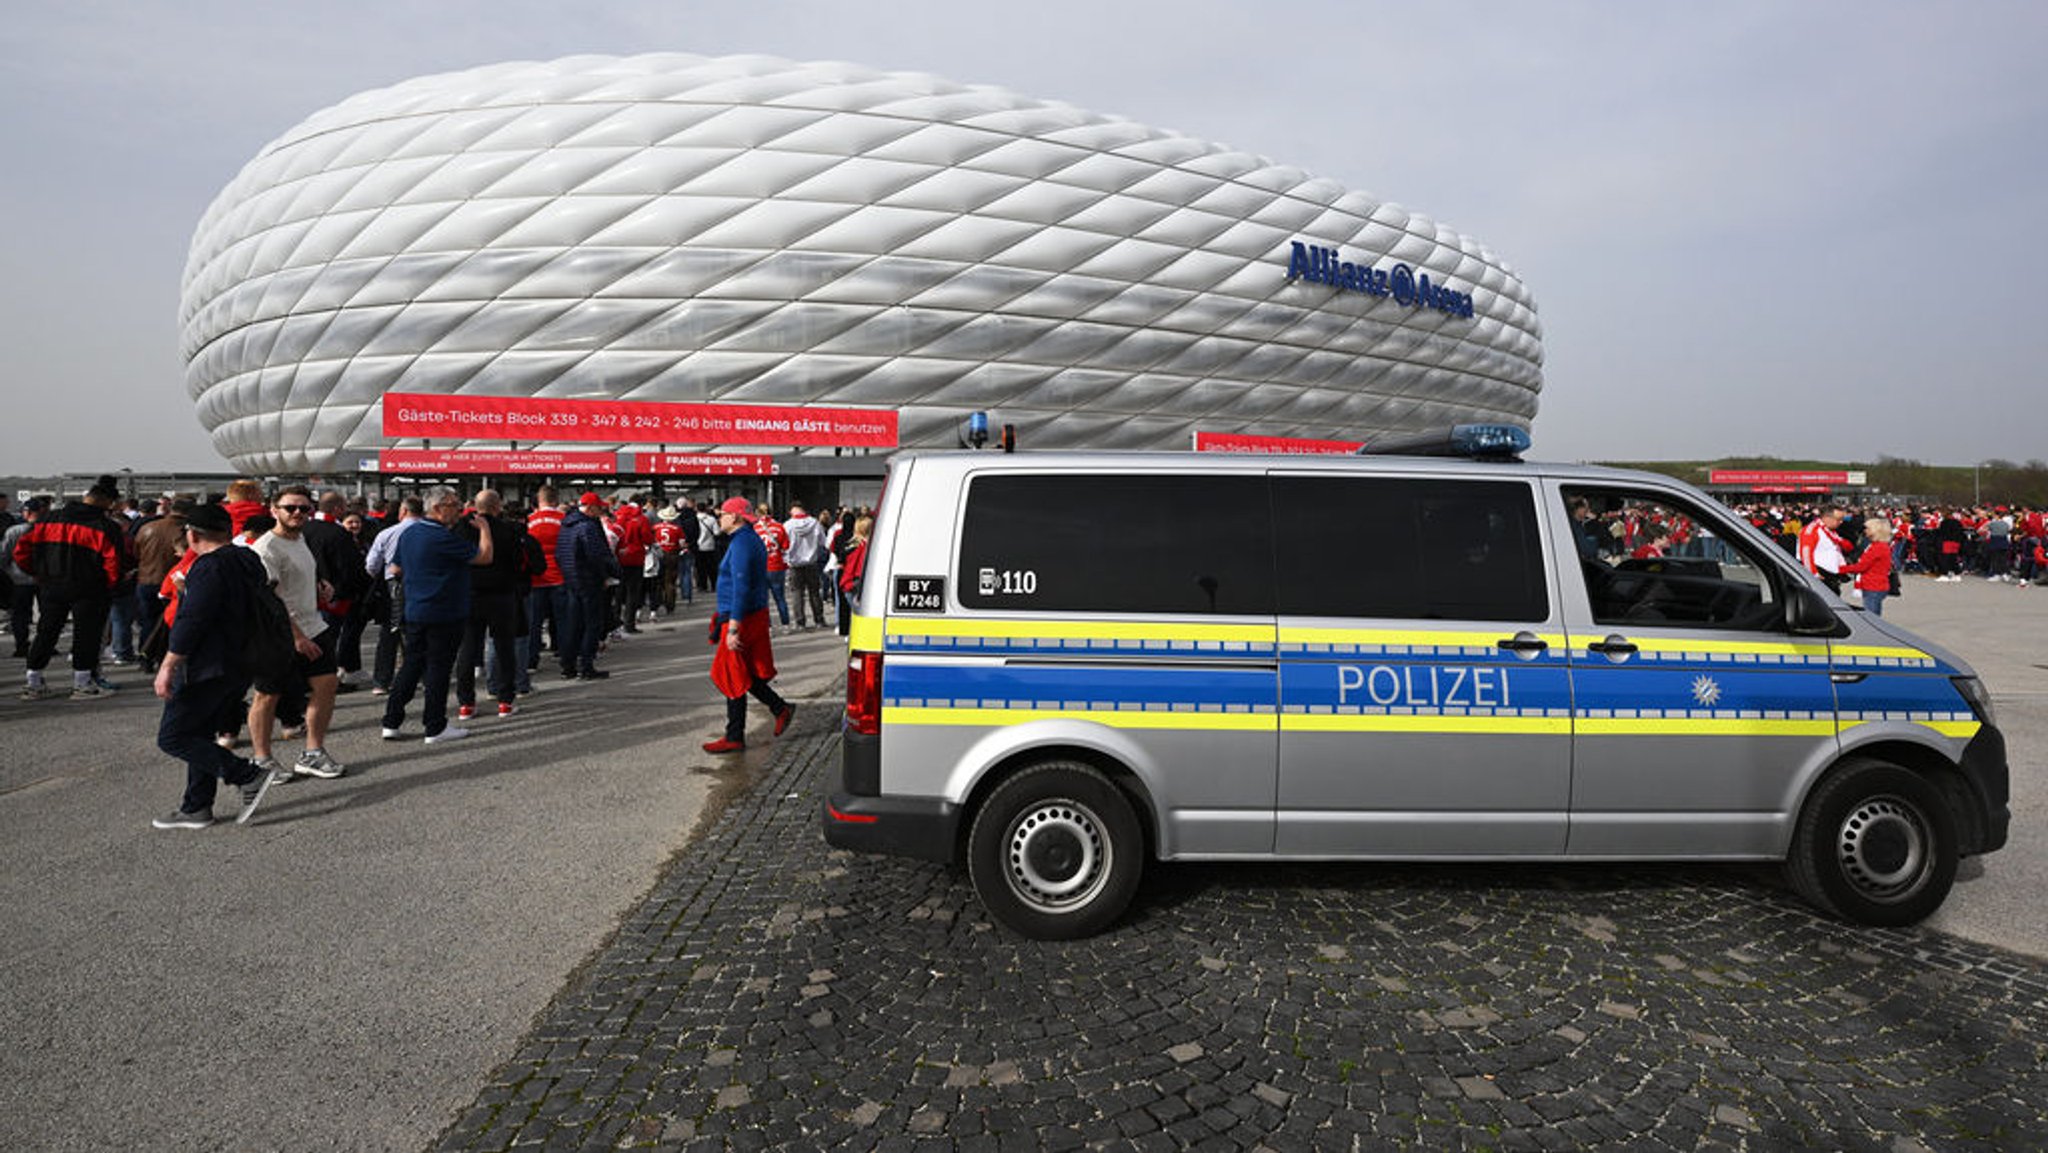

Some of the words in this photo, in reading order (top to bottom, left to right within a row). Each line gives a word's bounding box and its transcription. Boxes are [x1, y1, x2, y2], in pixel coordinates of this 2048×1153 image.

[1288, 241, 1390, 297] Allianz
[1418, 273, 1474, 318] Arena
[398, 408, 503, 424] Gäste-Tickets
[507, 412, 546, 425] Block
[550, 414, 578, 426] 339
[591, 415, 617, 427] 347
[620, 416, 631, 427] &
[634, 416, 660, 428] 242
[673, 417, 699, 429] 246
[702, 418, 731, 430] bitte
[734, 418, 790, 431] EINGANG
[793, 419, 831, 432] GÄSTE
[833, 424, 886, 434] benutzen
[666, 457, 748, 466] FRAUENEINGANG
[661, 528, 670, 543] 5
[909, 580, 930, 592] BY
[1002, 571, 1036, 594] 110
[898, 594, 909, 606] M
[911, 594, 940, 608] 7248
[1338, 666, 1509, 706] POLIZEI
